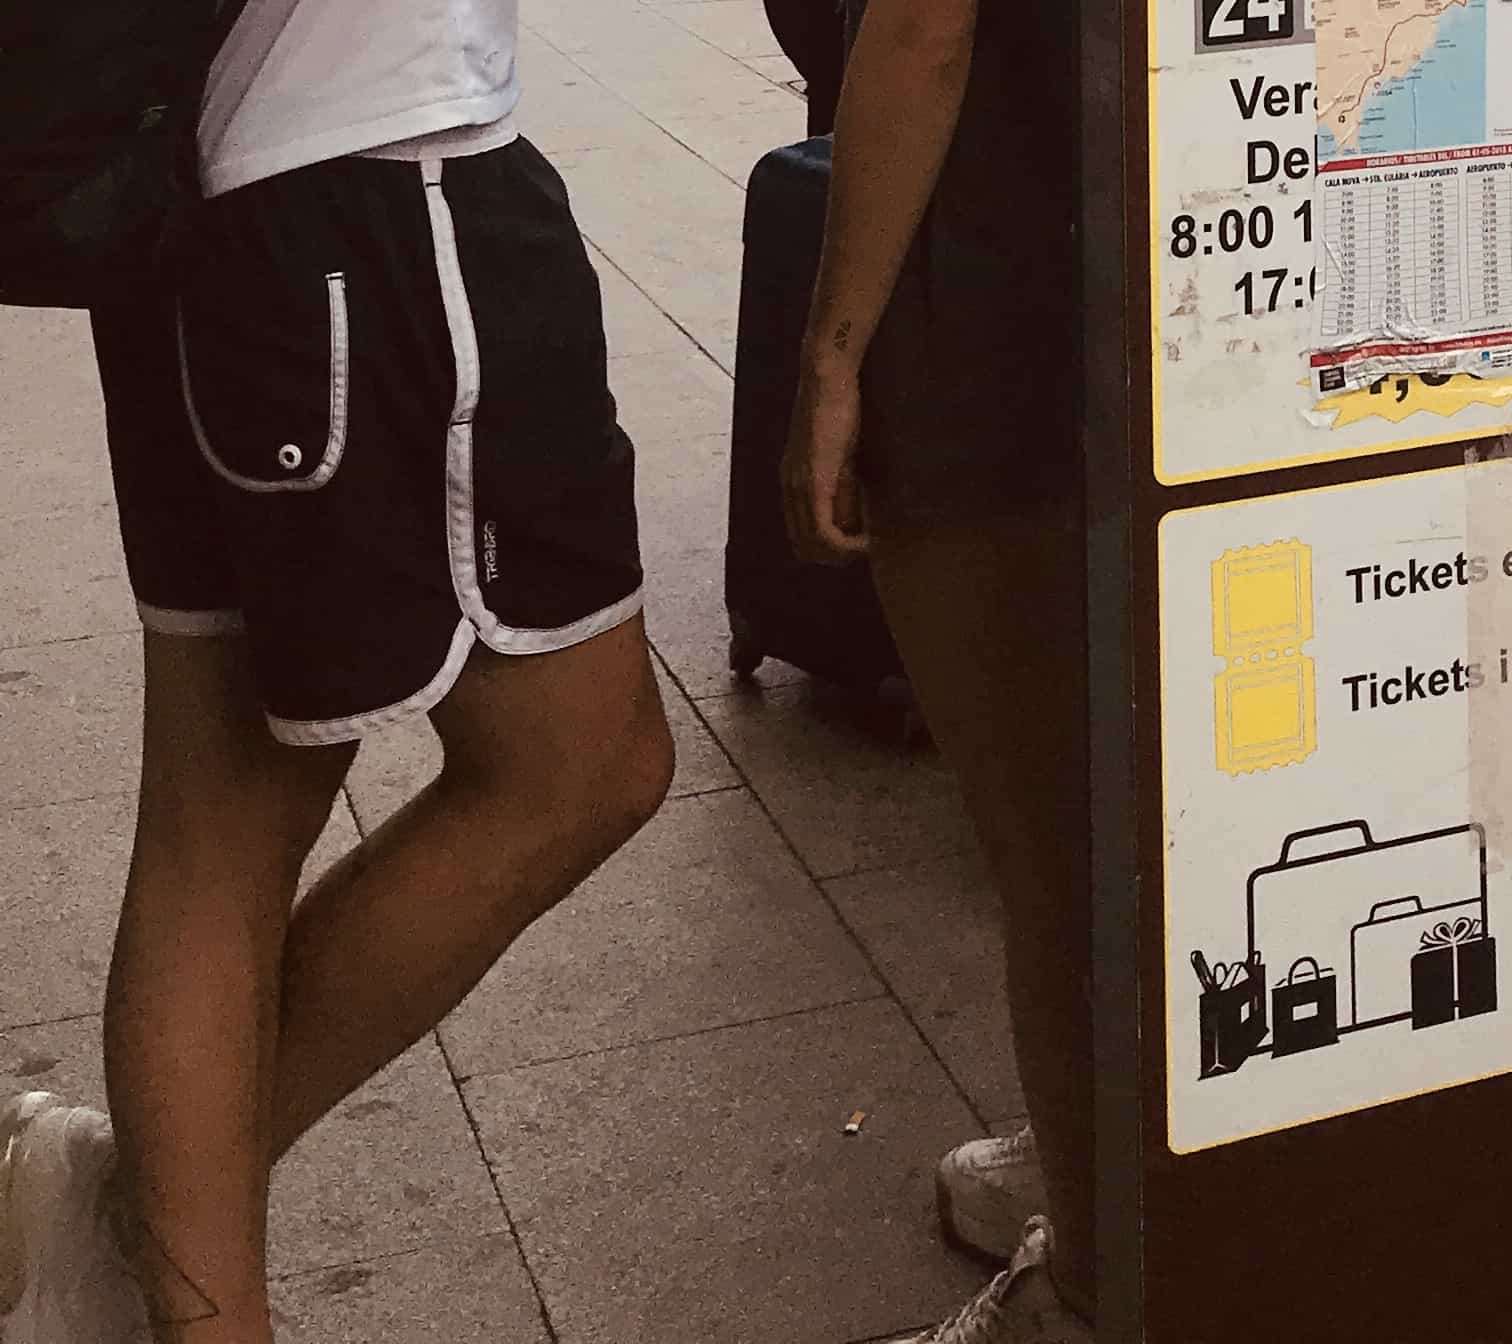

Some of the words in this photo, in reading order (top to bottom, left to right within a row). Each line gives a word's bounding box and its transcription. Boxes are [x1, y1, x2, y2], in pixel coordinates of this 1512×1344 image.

[1229, 76, 1318, 120] Ver
[1171, 205, 1274, 259] 8:00
[1235, 266, 1316, 316] 17:
[1346, 550, 1488, 604] Tickets
[1342, 660, 1485, 712] Tickets
